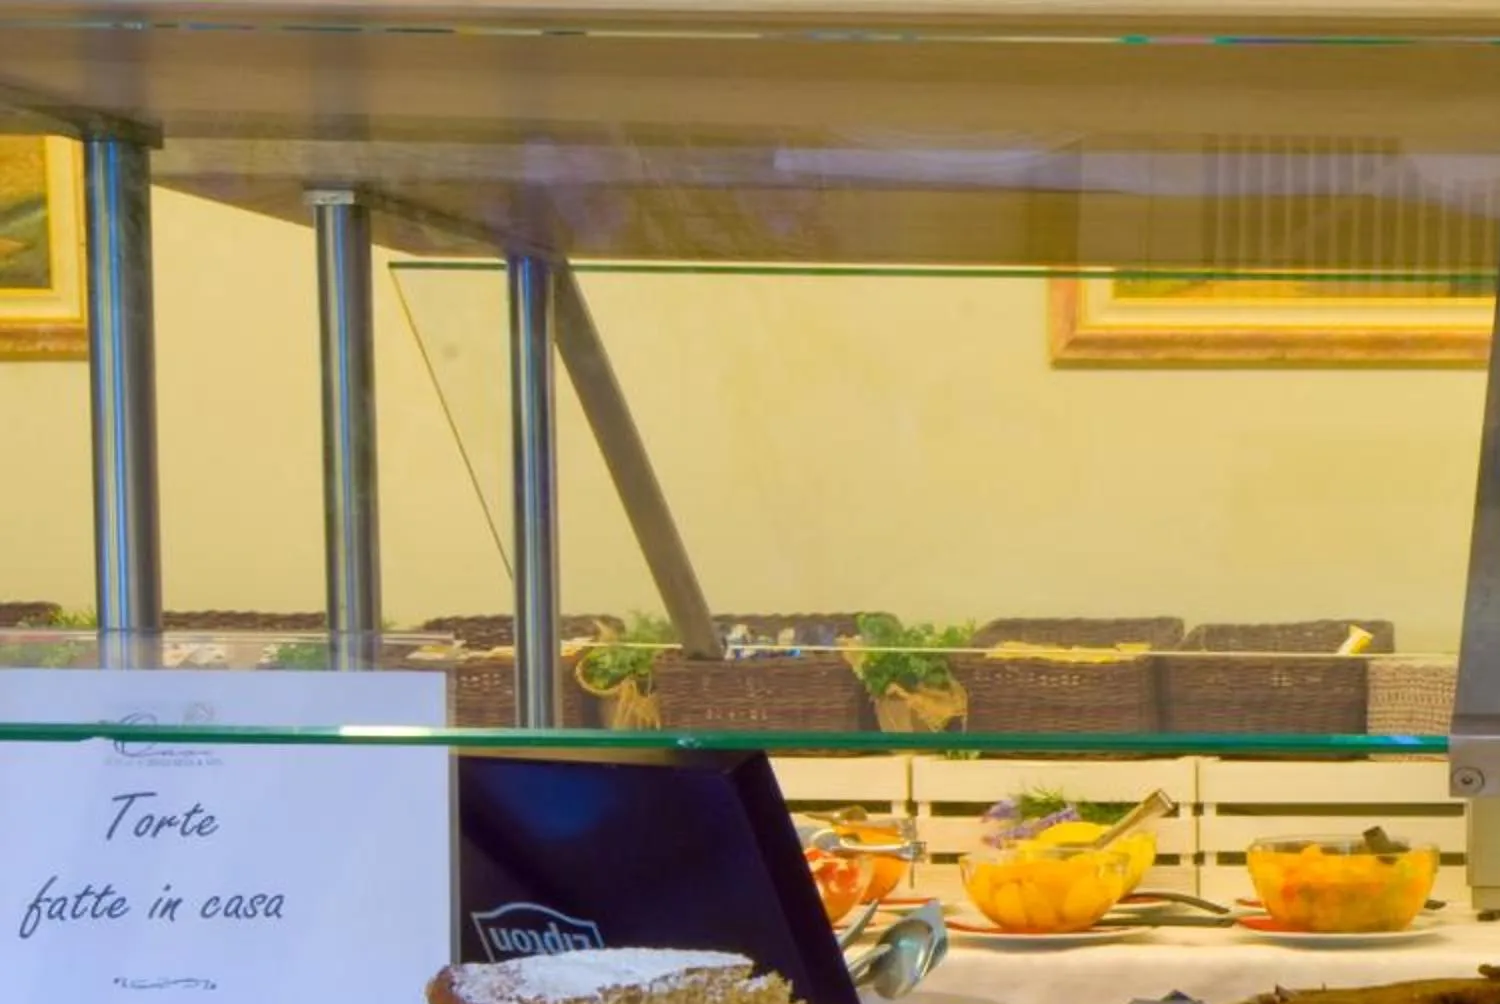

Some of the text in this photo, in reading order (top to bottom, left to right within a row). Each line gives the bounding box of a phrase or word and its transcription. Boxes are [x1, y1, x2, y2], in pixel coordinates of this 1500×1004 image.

[106, 792, 219, 841] Torte
[19, 876, 285, 940] fatte in casa
